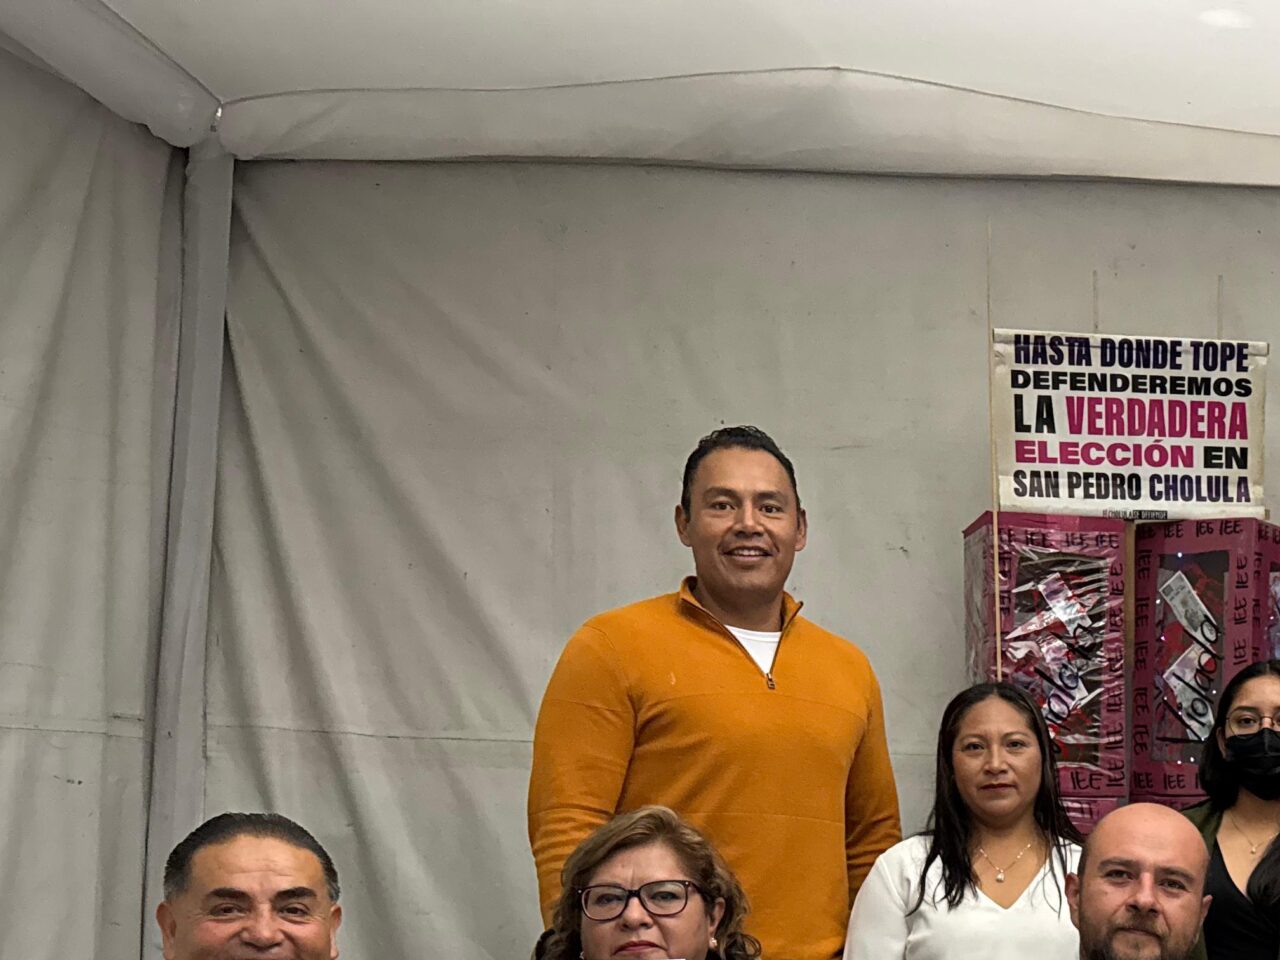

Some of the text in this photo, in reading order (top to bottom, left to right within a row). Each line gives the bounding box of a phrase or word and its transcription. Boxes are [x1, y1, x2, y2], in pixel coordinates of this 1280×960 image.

[1014, 334, 1249, 372] HASTA DONDE TOPE
[1011, 369, 1252, 397] DEFENDEREMOS
[1014, 394, 1248, 440] LA VERDADERA
[1015, 439, 1248, 469] ELECCIÓN EN
[1013, 470, 1251, 502] SAN PEDRO CHOLULA
[1219, 520, 1244, 535] IEE
[1163, 774, 1186, 790] IEE
